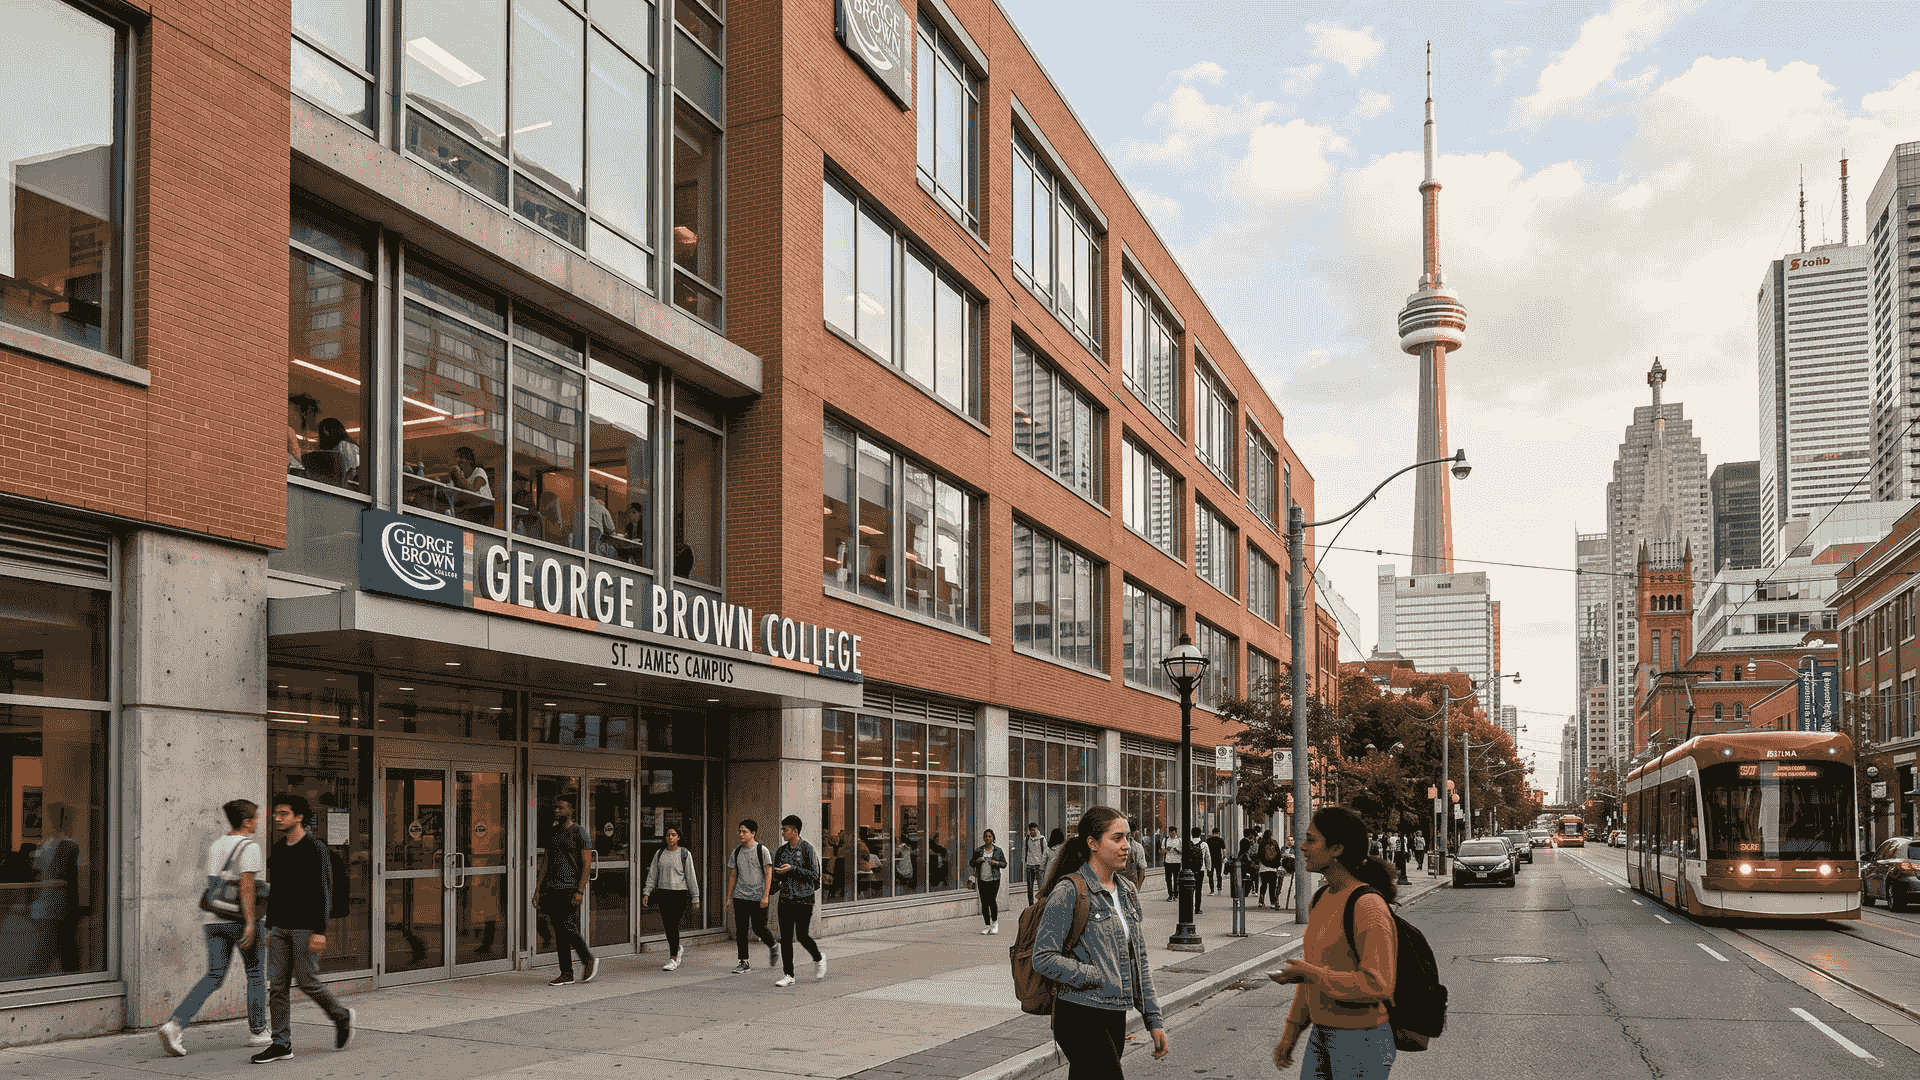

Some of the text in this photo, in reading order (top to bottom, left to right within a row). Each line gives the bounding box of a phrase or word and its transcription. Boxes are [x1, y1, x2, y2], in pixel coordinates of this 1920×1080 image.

[394, 528, 454, 556] GEORGE
[401, 545, 455, 571] BROWN
[486, 544, 862, 674] GEORGE BROWN COLLEGE
[611, 642, 734, 684] ST. JAMES CAMPUS
